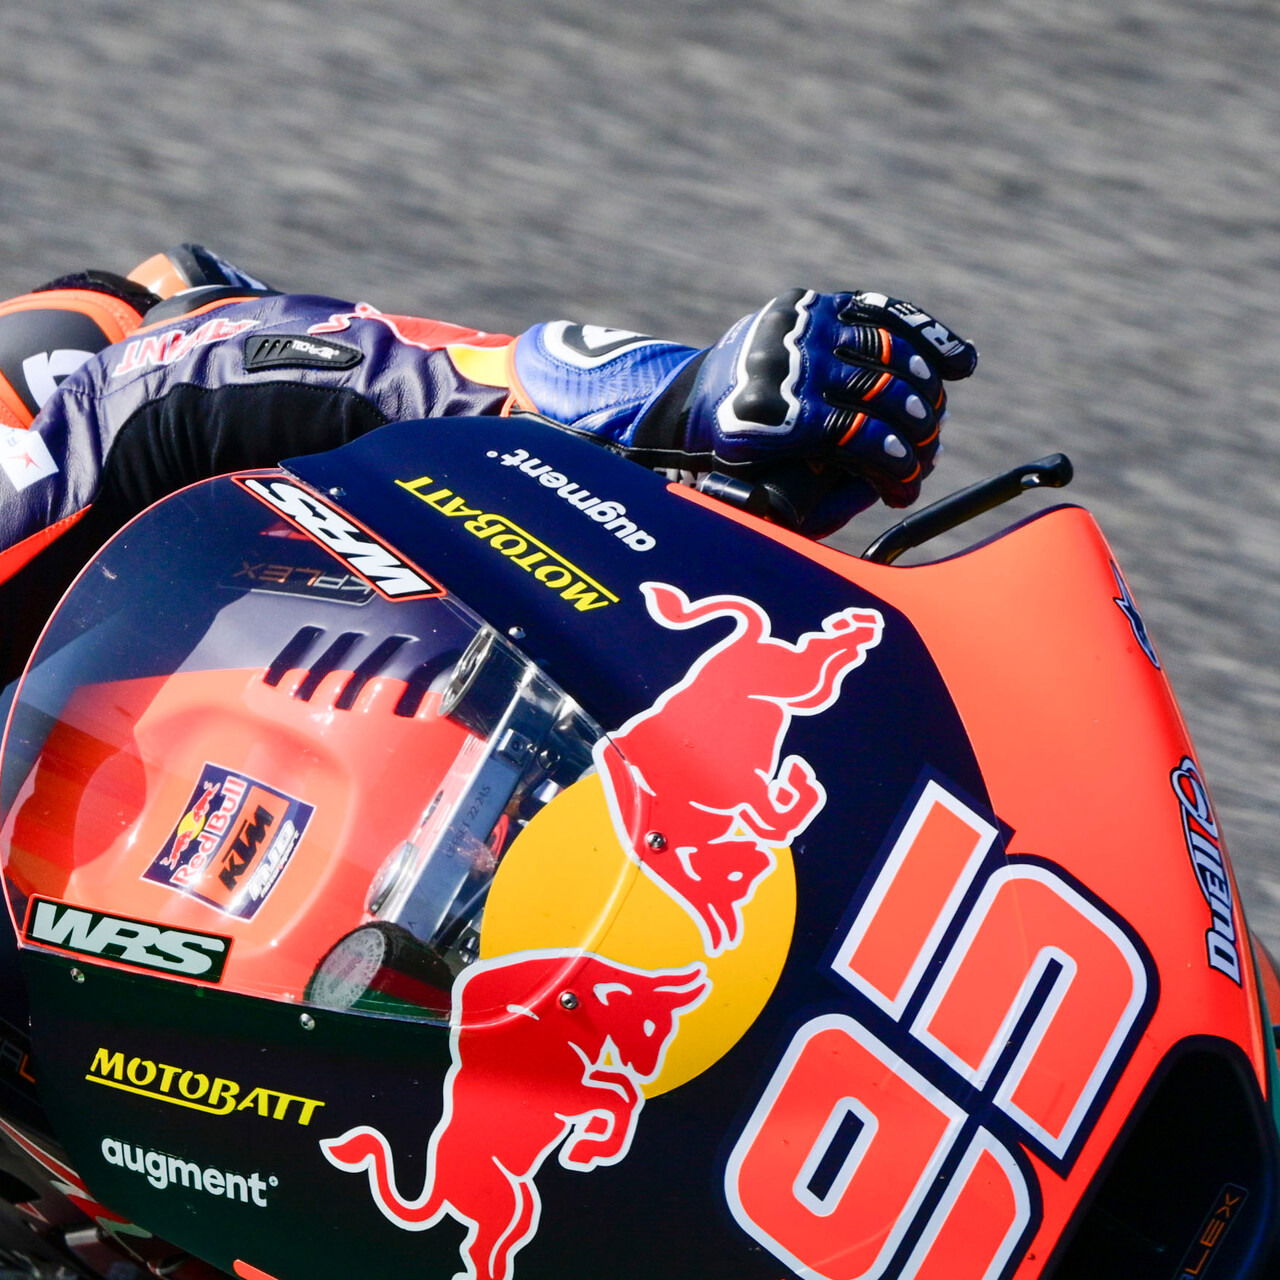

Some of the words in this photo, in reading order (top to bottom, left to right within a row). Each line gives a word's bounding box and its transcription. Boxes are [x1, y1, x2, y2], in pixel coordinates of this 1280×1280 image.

[244, 479, 434, 596] WRS
[394, 475, 620, 612] MOTOBATT
[170, 829, 223, 888] Red
[203, 774, 250, 836] Bull
[218, 804, 274, 892] KTM
[32, 902, 226, 974] WRS
[84, 1047, 327, 1127] MOTOBATT
[101, 1136, 269, 1208] augment
